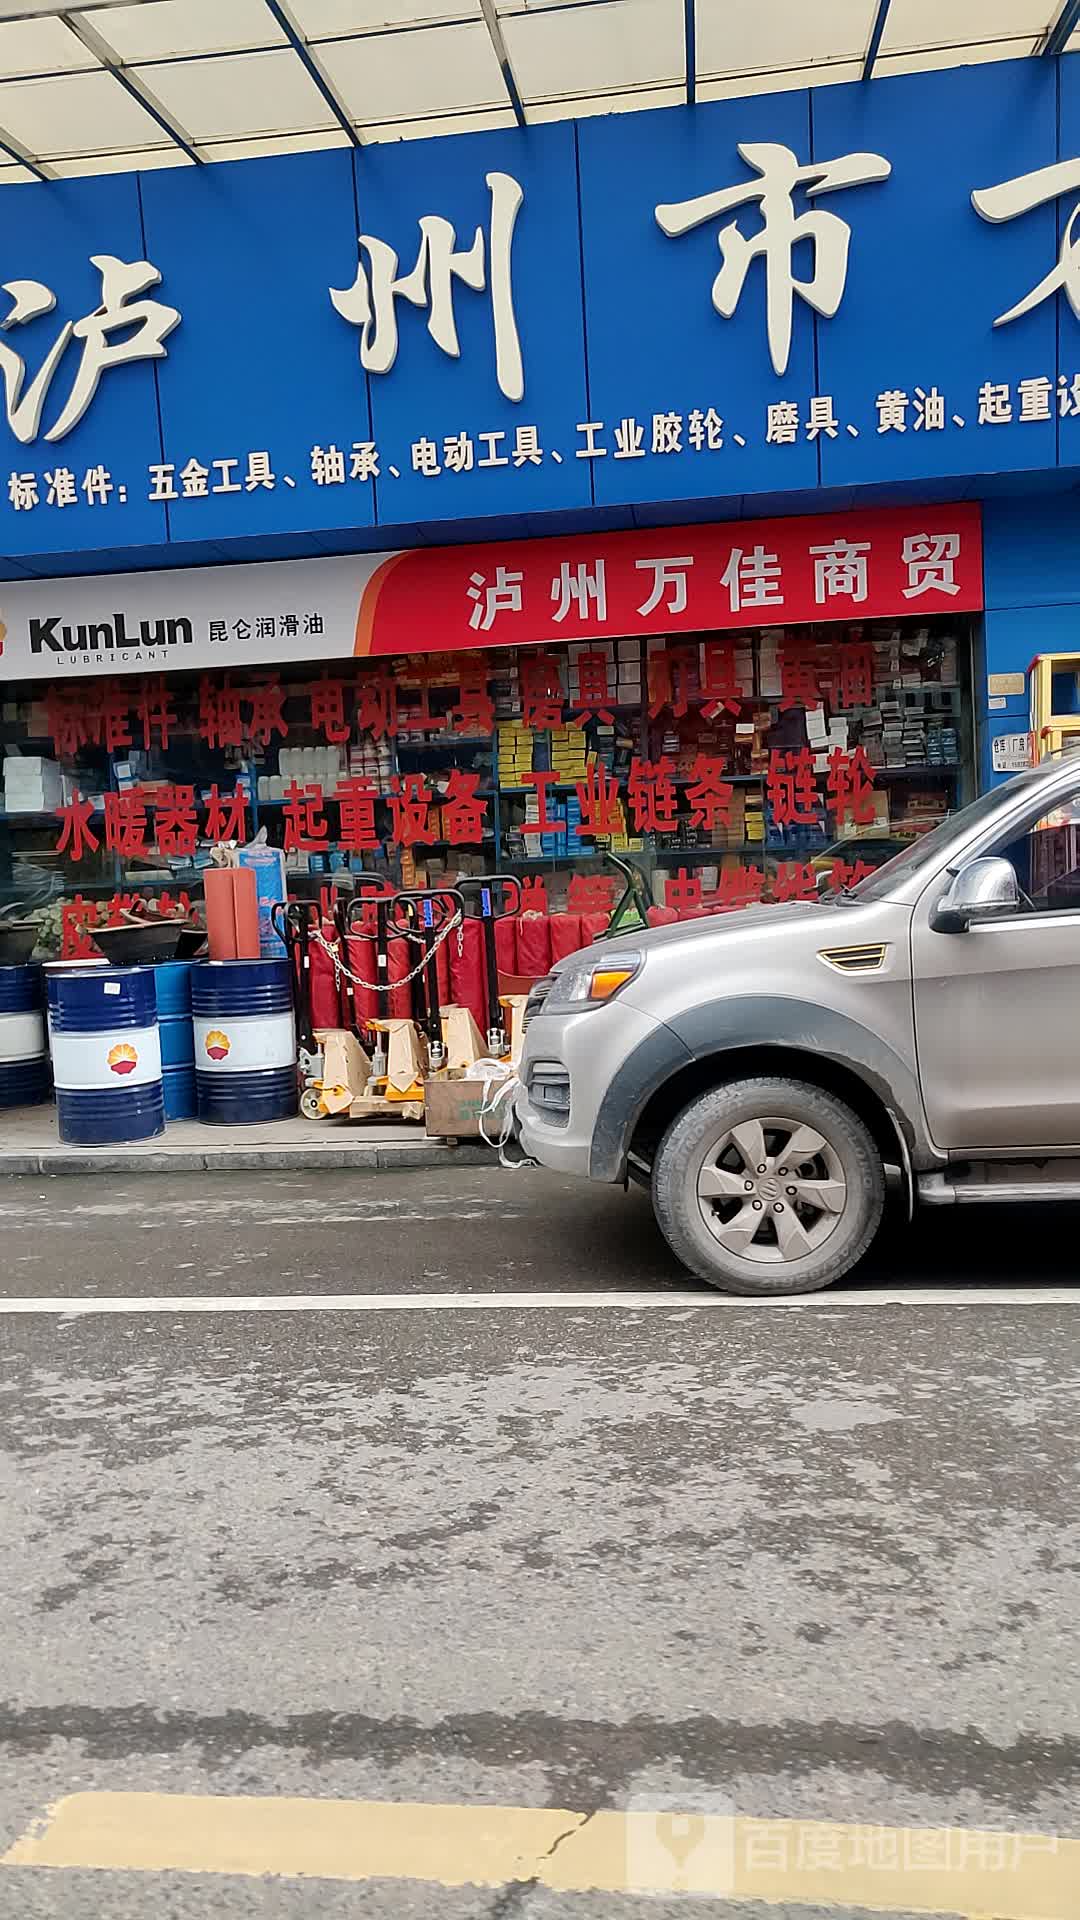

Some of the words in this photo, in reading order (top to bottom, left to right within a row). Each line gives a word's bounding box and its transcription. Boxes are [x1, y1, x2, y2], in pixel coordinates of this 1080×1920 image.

[467, 533, 962, 631] 泸州万佳商贸
[29, 613, 193, 653] KunLun
[208, 612, 325, 642] 昆仑润滑油
[56, 650, 169, 665] LUBRICANT
[55, 782, 250, 862] 水暖器材
[282, 768, 488, 853] 起重设备
[519, 752, 735, 836] 工业链条
[767, 744, 877, 826] 链轮
